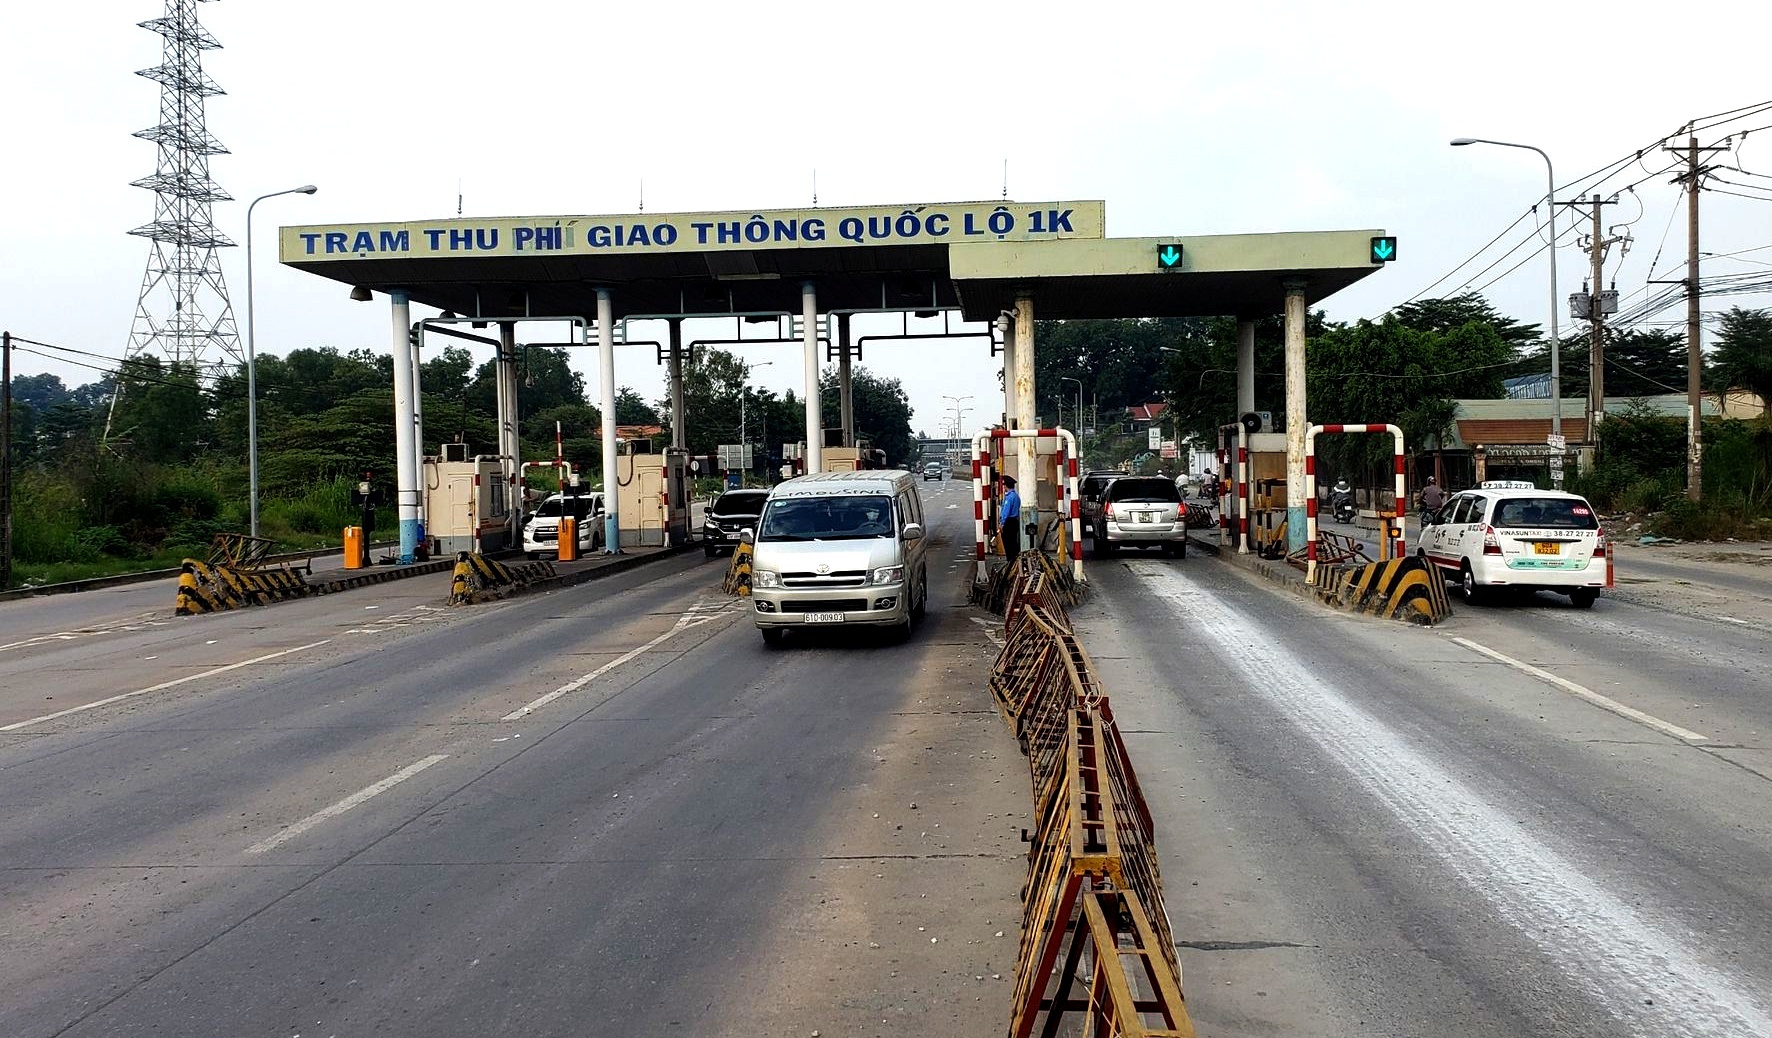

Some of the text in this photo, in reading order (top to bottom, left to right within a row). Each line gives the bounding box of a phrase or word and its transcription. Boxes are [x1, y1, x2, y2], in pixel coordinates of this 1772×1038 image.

[299, 206, 1075, 258] TRẠM THU PHÍ GIAO THÔNG QUỐC LỘ 1K
